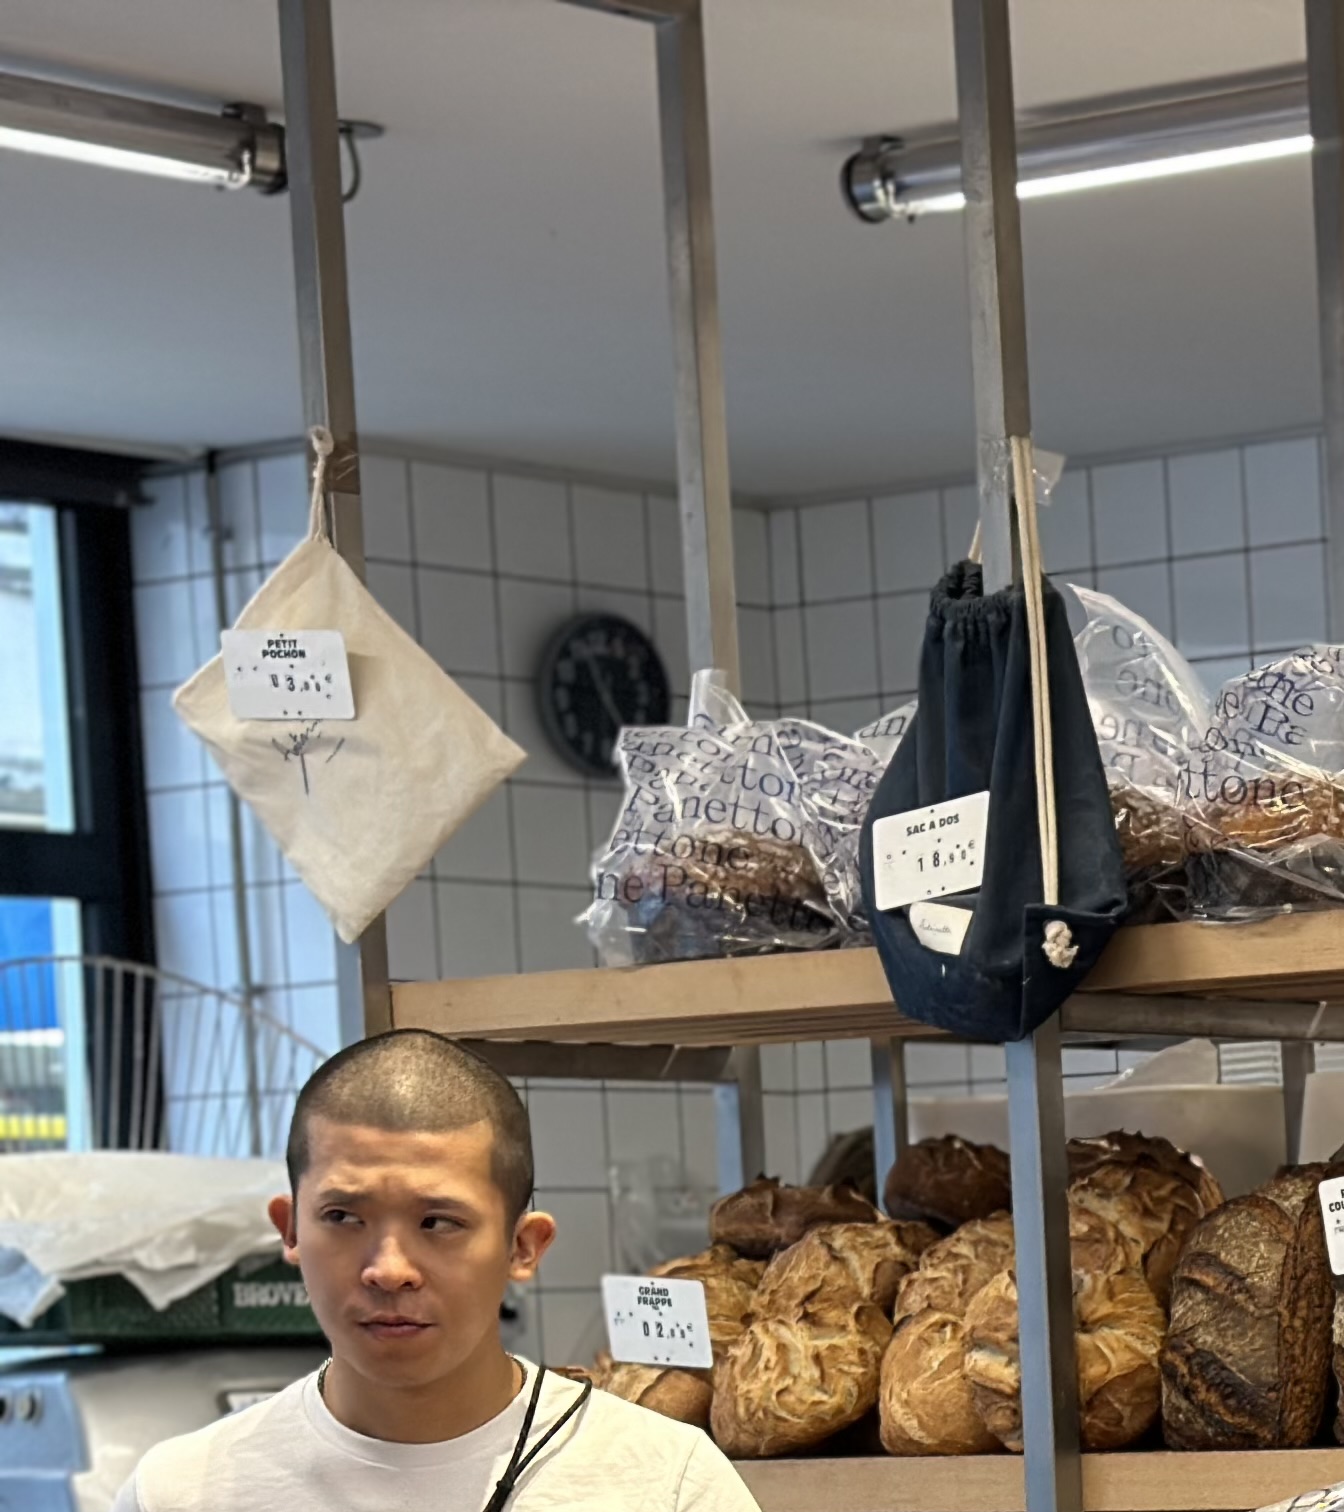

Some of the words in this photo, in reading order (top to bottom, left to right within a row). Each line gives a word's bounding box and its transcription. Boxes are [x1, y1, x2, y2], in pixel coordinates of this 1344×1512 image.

[267, 639, 297, 648] PETIT
[262, 650, 306, 658] POCHON
[906, 822, 926, 837] SAC
[929, 820, 936, 830] A
[939, 813, 960, 828] DOS
[638, 1286, 669, 1297] GRAND
[637, 1296, 672, 1307] FRAPPE
